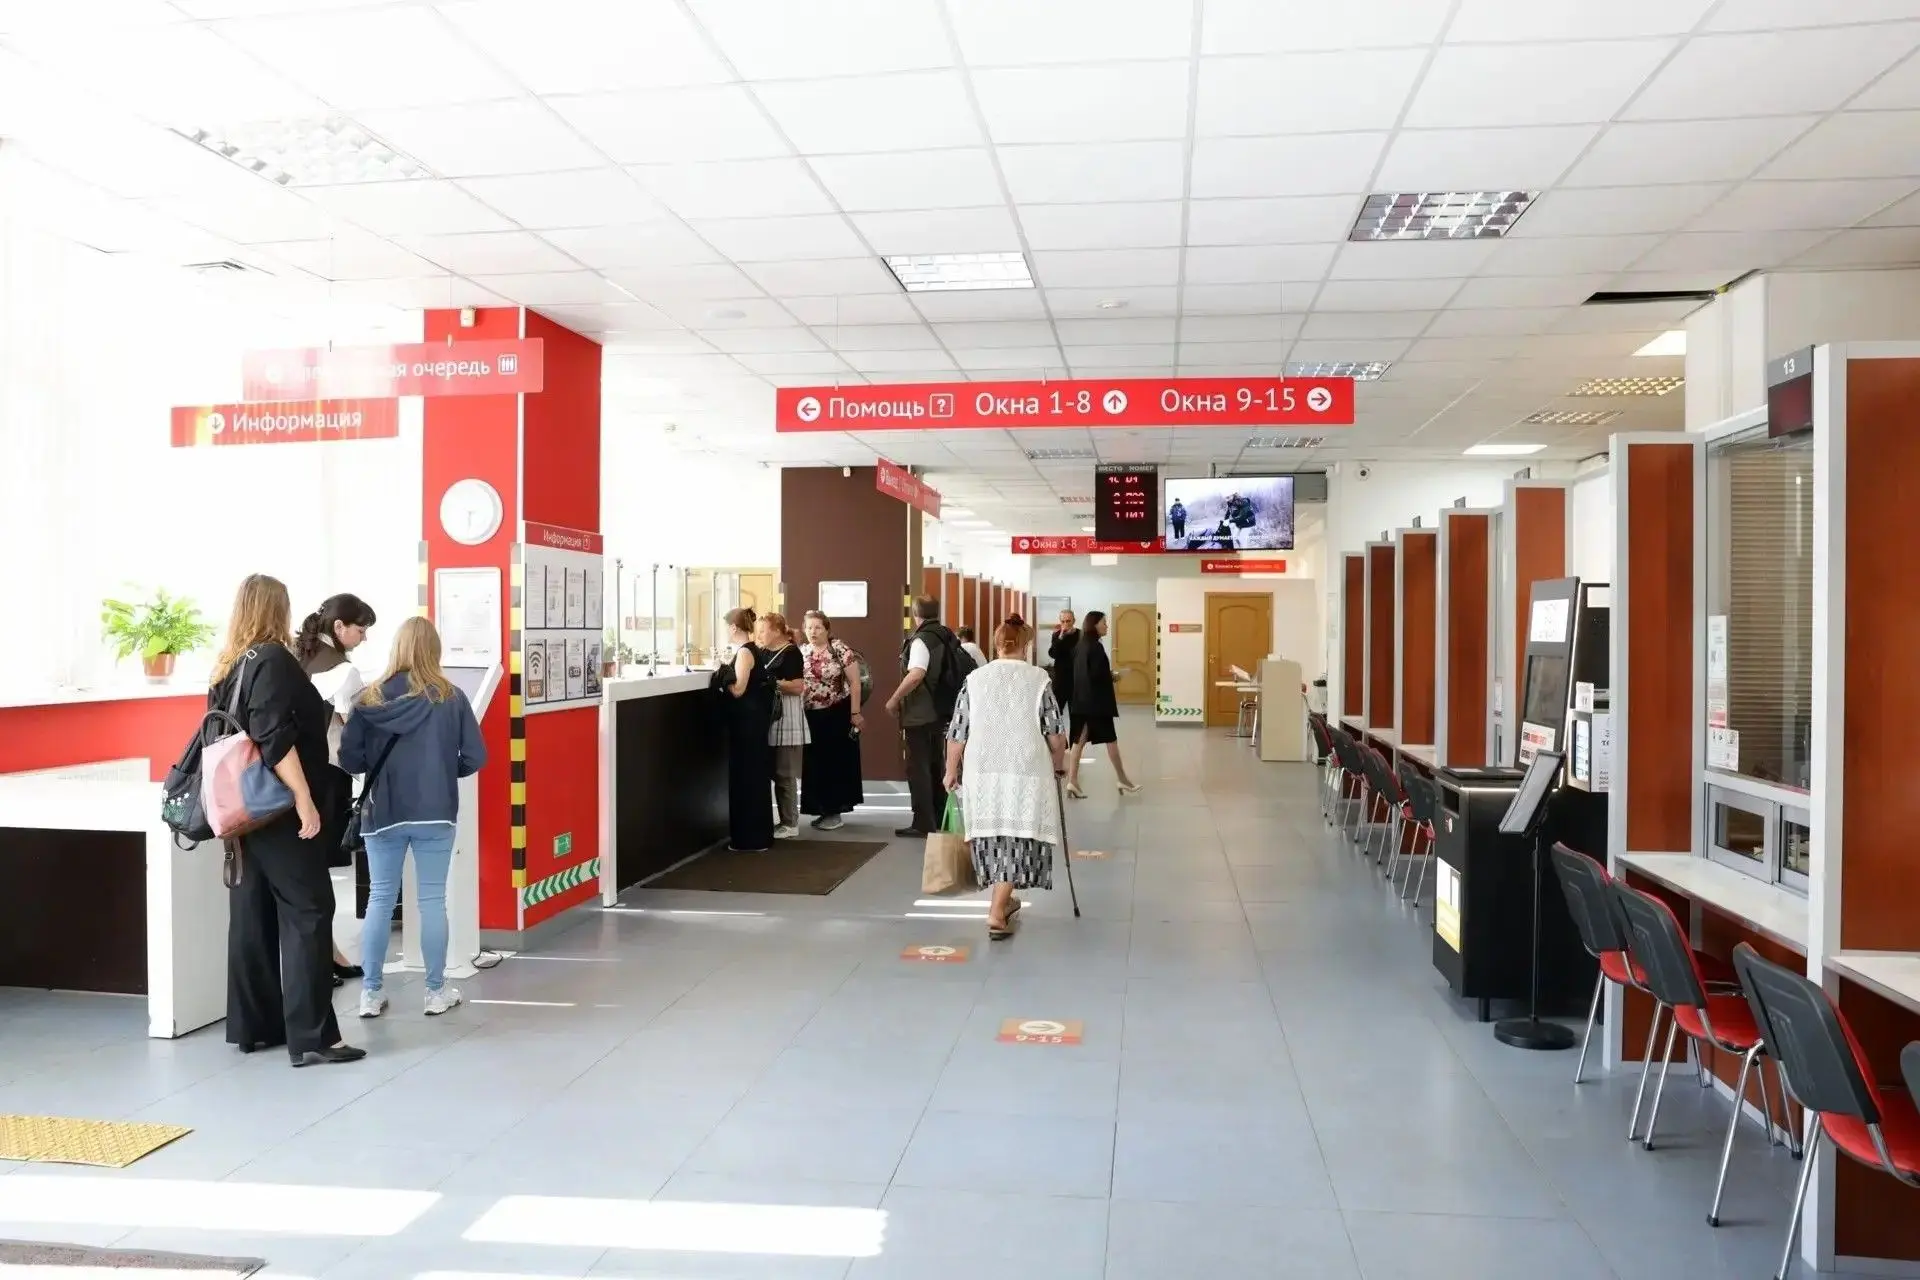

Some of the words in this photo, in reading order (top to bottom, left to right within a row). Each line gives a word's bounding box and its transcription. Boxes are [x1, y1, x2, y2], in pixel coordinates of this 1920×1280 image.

[412, 360, 491, 380] очередь
[1783, 358, 1796, 375] 13
[829, 396, 925, 420] Помощь
[975, 391, 1040, 416] Окна
[1049, 390, 1091, 414] 1-8
[1160, 388, 1227, 413] Окна
[1236, 387, 1296, 412] 9-15
[233, 411, 362, 436] Информация
[543, 529, 582, 548] Информация
[1032, 539, 1058, 549] Окна
[1061, 539, 1077, 549] 1-8
[1015, 1034, 1063, 1043] 9-15
